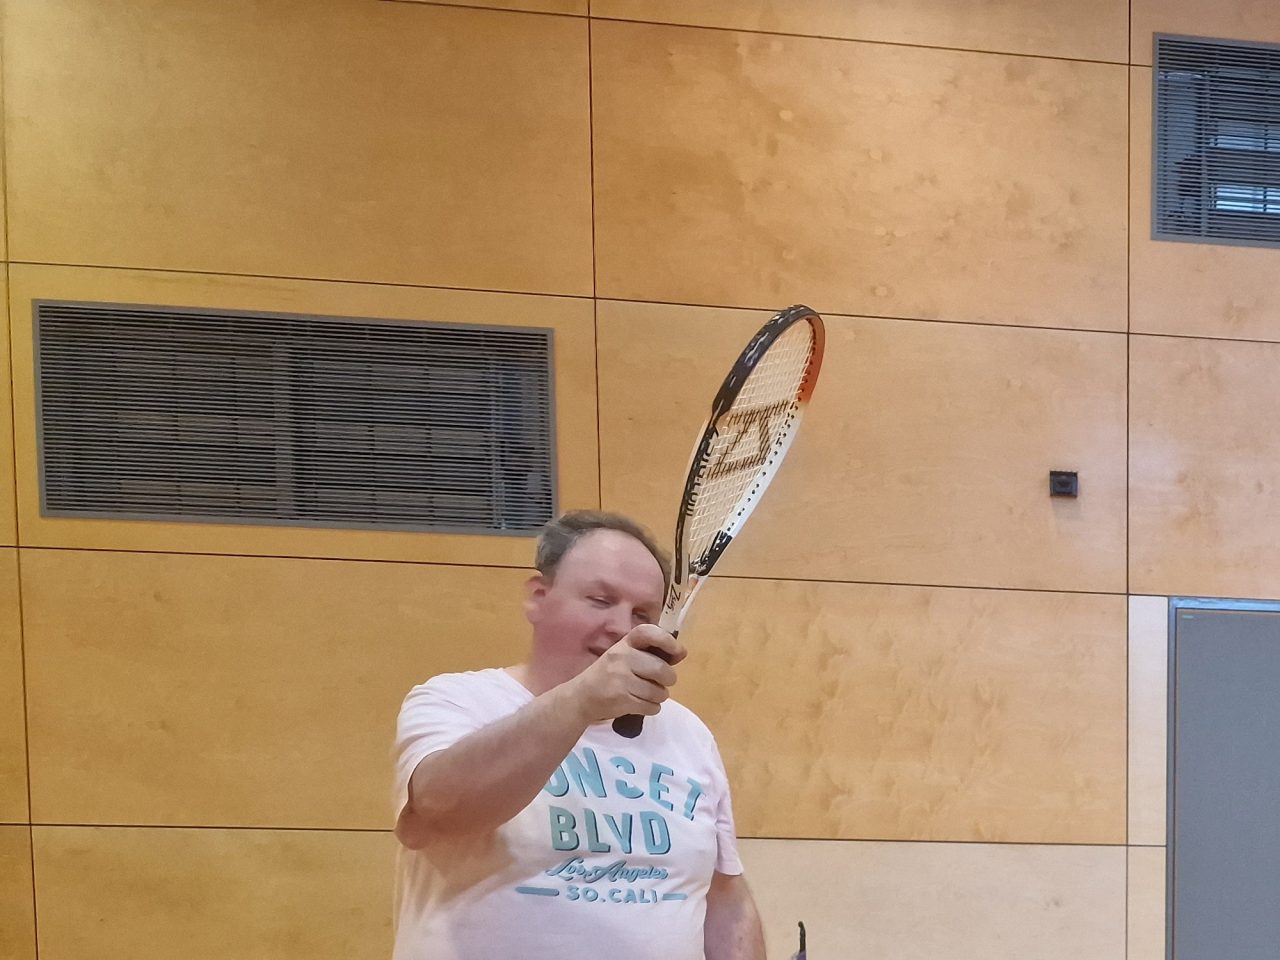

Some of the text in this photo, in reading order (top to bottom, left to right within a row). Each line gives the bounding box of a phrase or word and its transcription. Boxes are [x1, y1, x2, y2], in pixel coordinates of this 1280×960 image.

[549, 804, 672, 855] BLVD
[545, 856, 669, 883] Los Angeles
